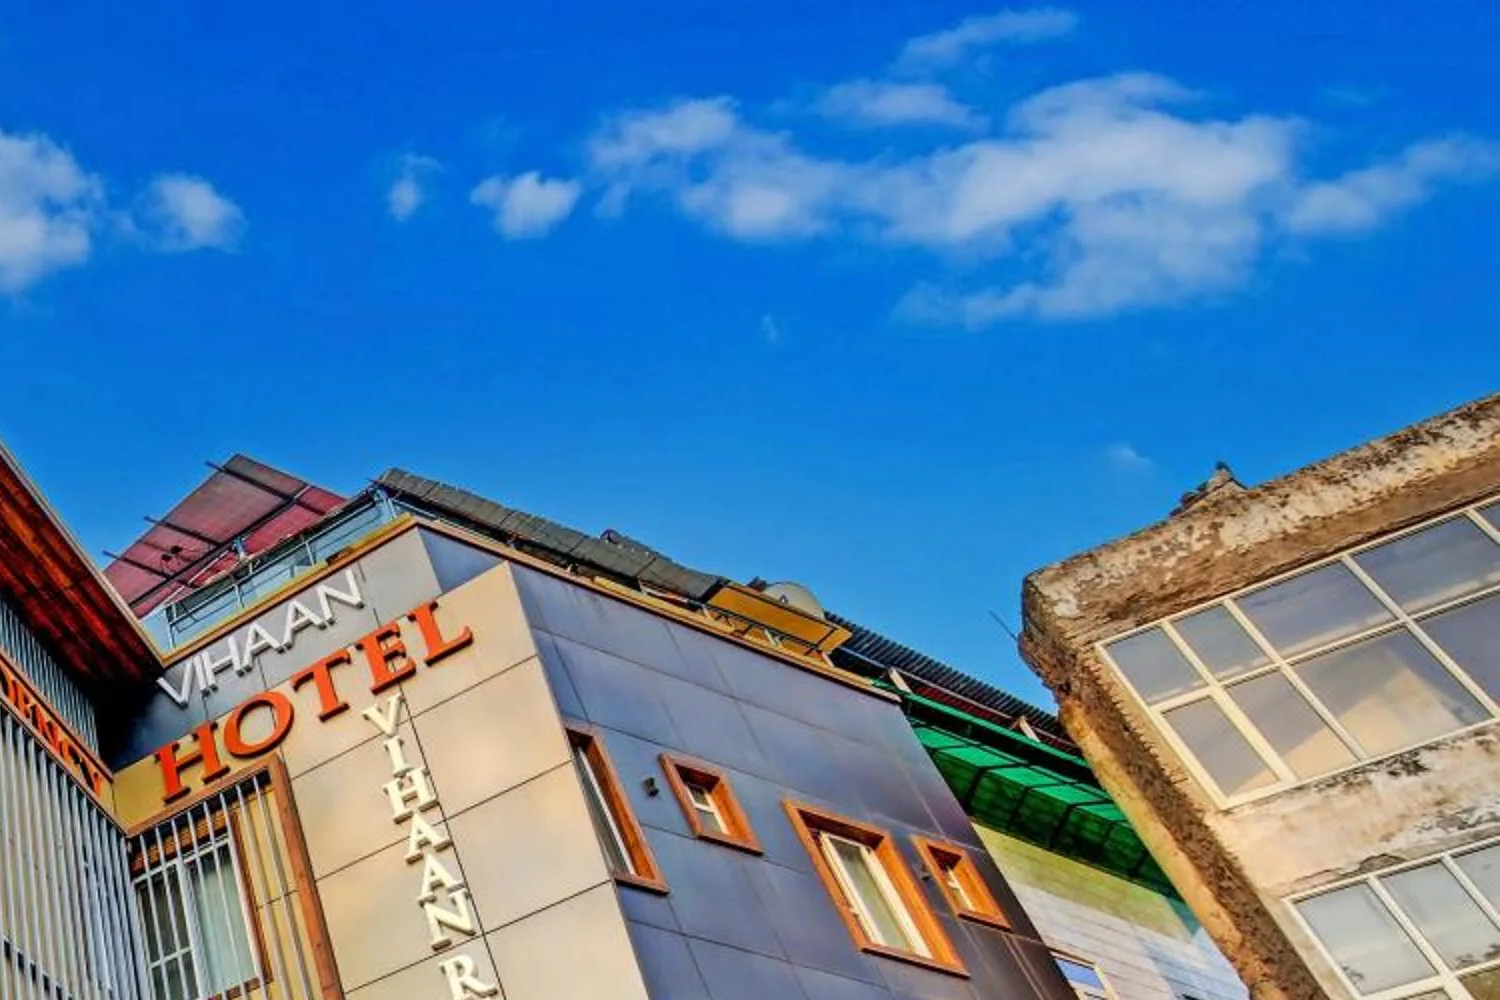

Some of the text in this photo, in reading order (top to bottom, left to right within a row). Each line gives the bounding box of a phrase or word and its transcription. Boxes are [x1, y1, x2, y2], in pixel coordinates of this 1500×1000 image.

[154, 600, 474, 805] HOTEL
[156, 567, 367, 710] VIHAAN
[362, 694, 479, 950] VIHAAN
